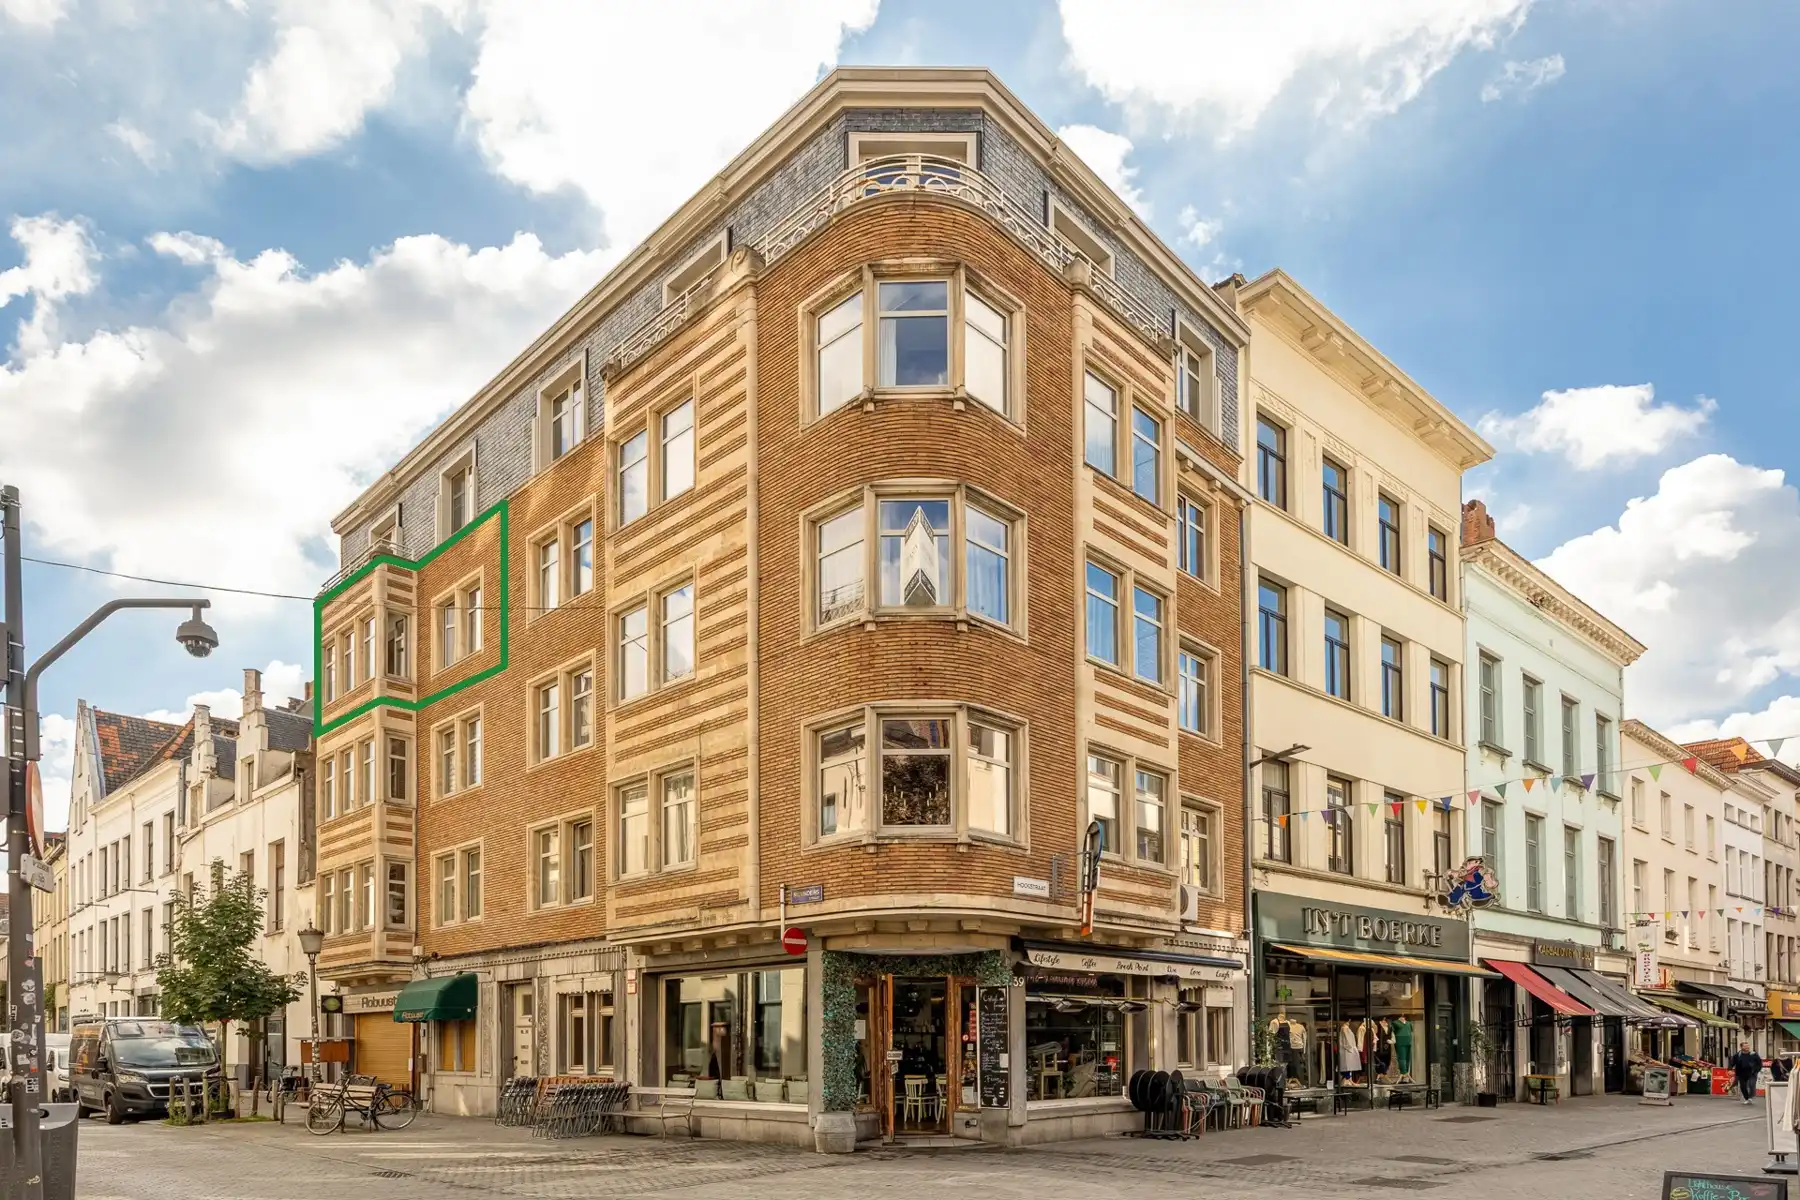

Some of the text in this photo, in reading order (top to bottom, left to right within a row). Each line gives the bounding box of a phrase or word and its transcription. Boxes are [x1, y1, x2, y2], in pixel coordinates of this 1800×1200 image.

[1017, 882, 1046, 891] HOOGSTRAAT
[1356, 915, 1442, 948] BOERKE
[1034, 952, 1060, 966] Lifestyle
[1081, 958, 1097, 969] Coffee
[1013, 976, 1025, 987] 39
[361, 996, 397, 1009] Robuust
[1688, 1179, 1733, 1190] Lighthouse
